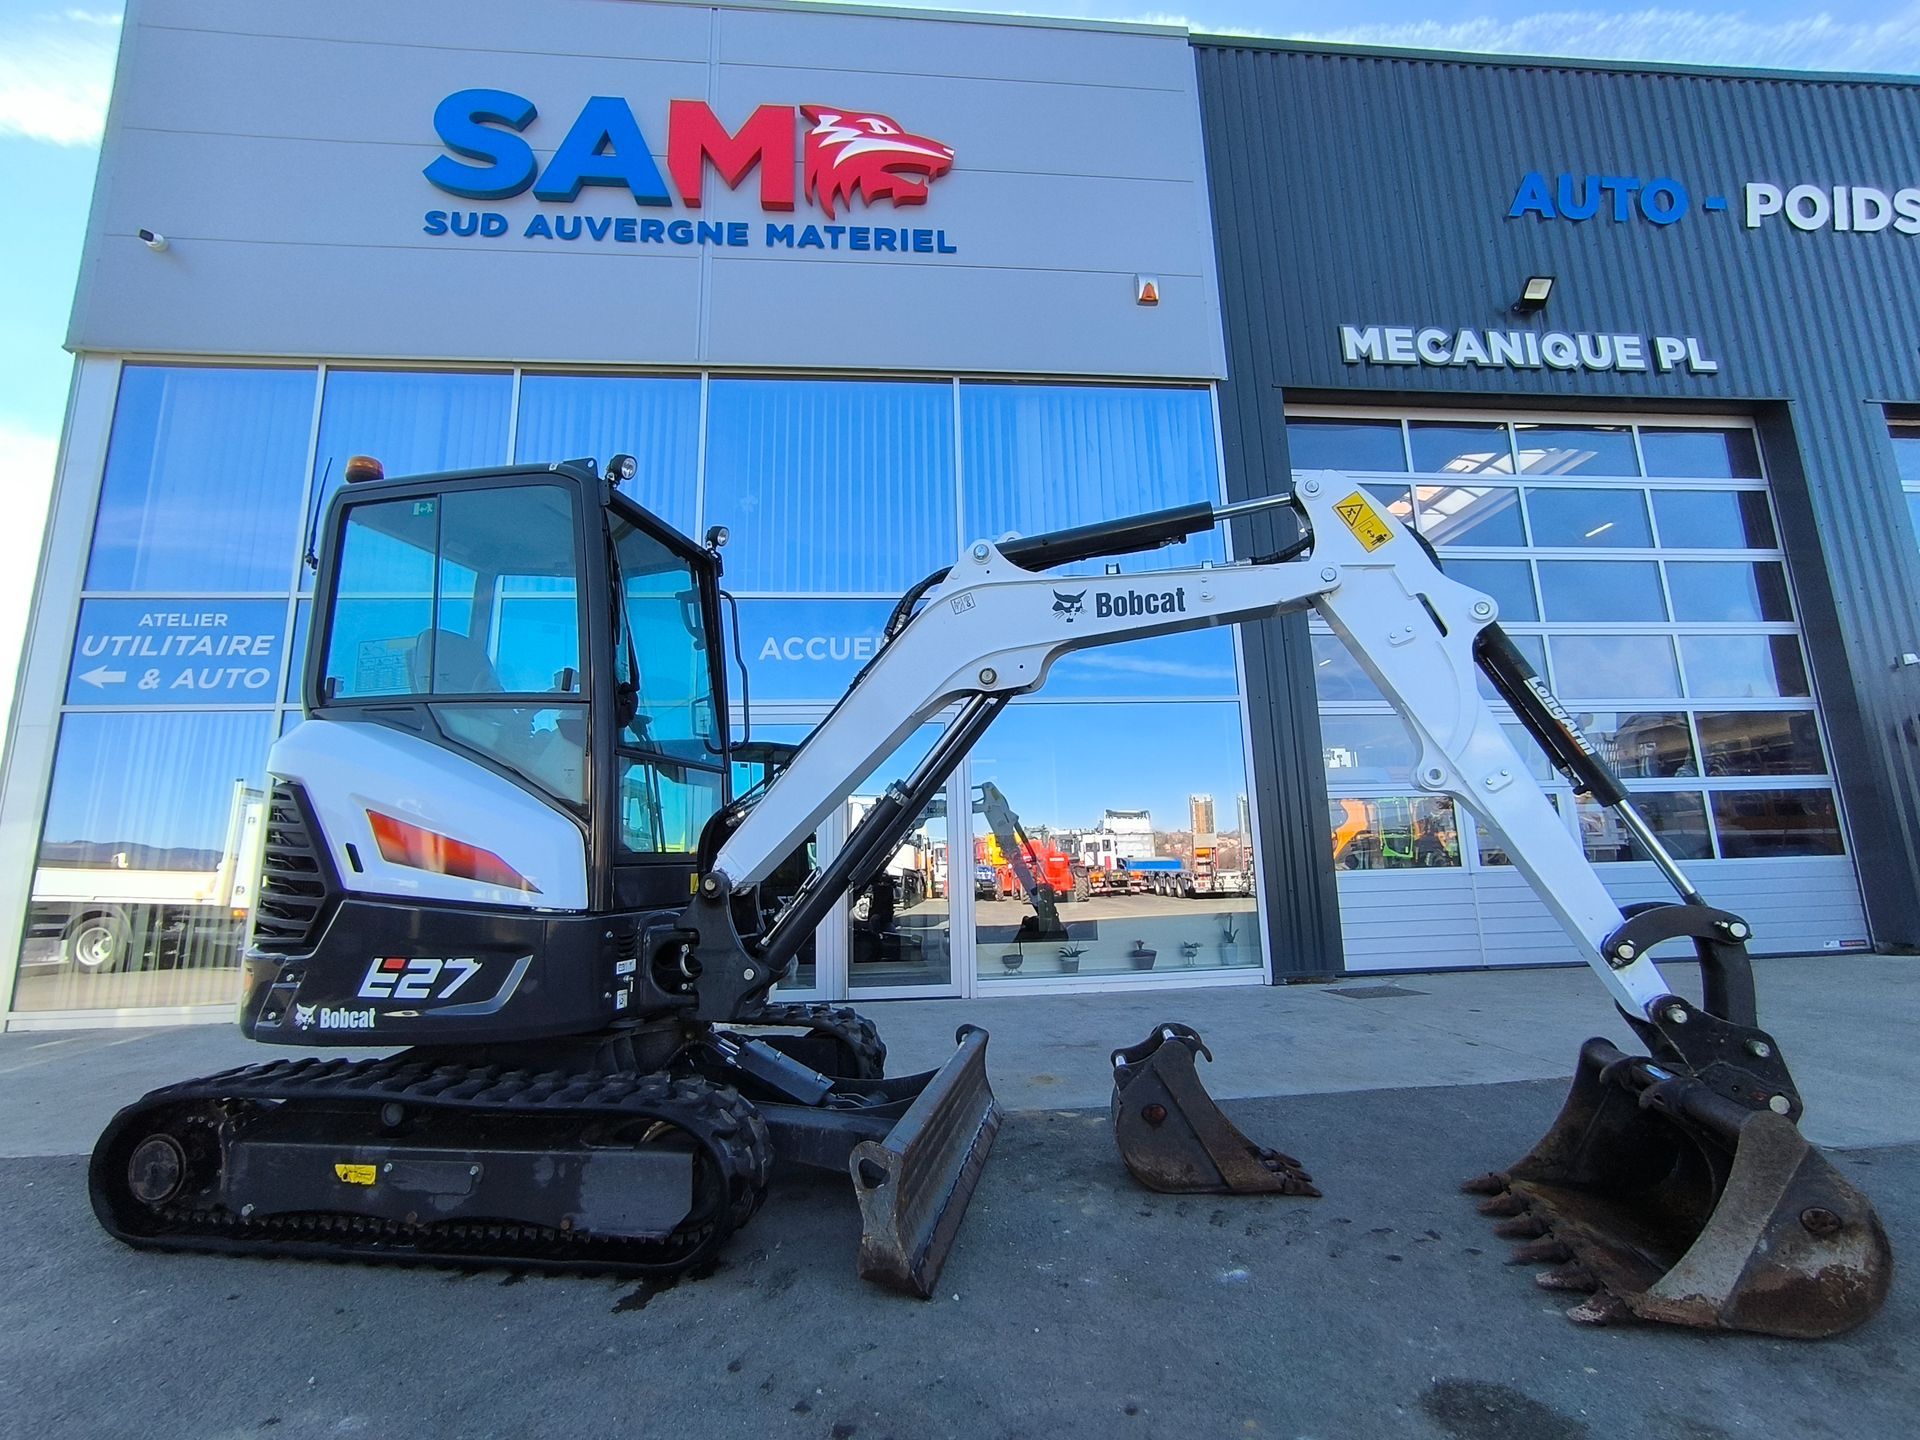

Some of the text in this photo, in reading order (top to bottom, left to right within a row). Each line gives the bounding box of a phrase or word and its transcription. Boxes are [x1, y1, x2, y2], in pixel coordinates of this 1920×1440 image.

[422, 88, 796, 212] SAM
[1507, 171, 1689, 224] AUTO
[1745, 182, 1920, 235] POIDS
[422, 209, 957, 254] SUD AUVERGNE MATERIEL
[1341, 325, 1718, 373] MECANIQUE PL
[138, 613, 228, 627] ATELIER
[1096, 587, 1186, 618] Bobcat
[81, 635, 275, 656] UTILITAIRE
[137, 667, 271, 689] & AUTO
[1523, 676, 1597, 755] LongArm
[357, 958, 483, 999] E27
[320, 1007, 376, 1029] Bobcat
